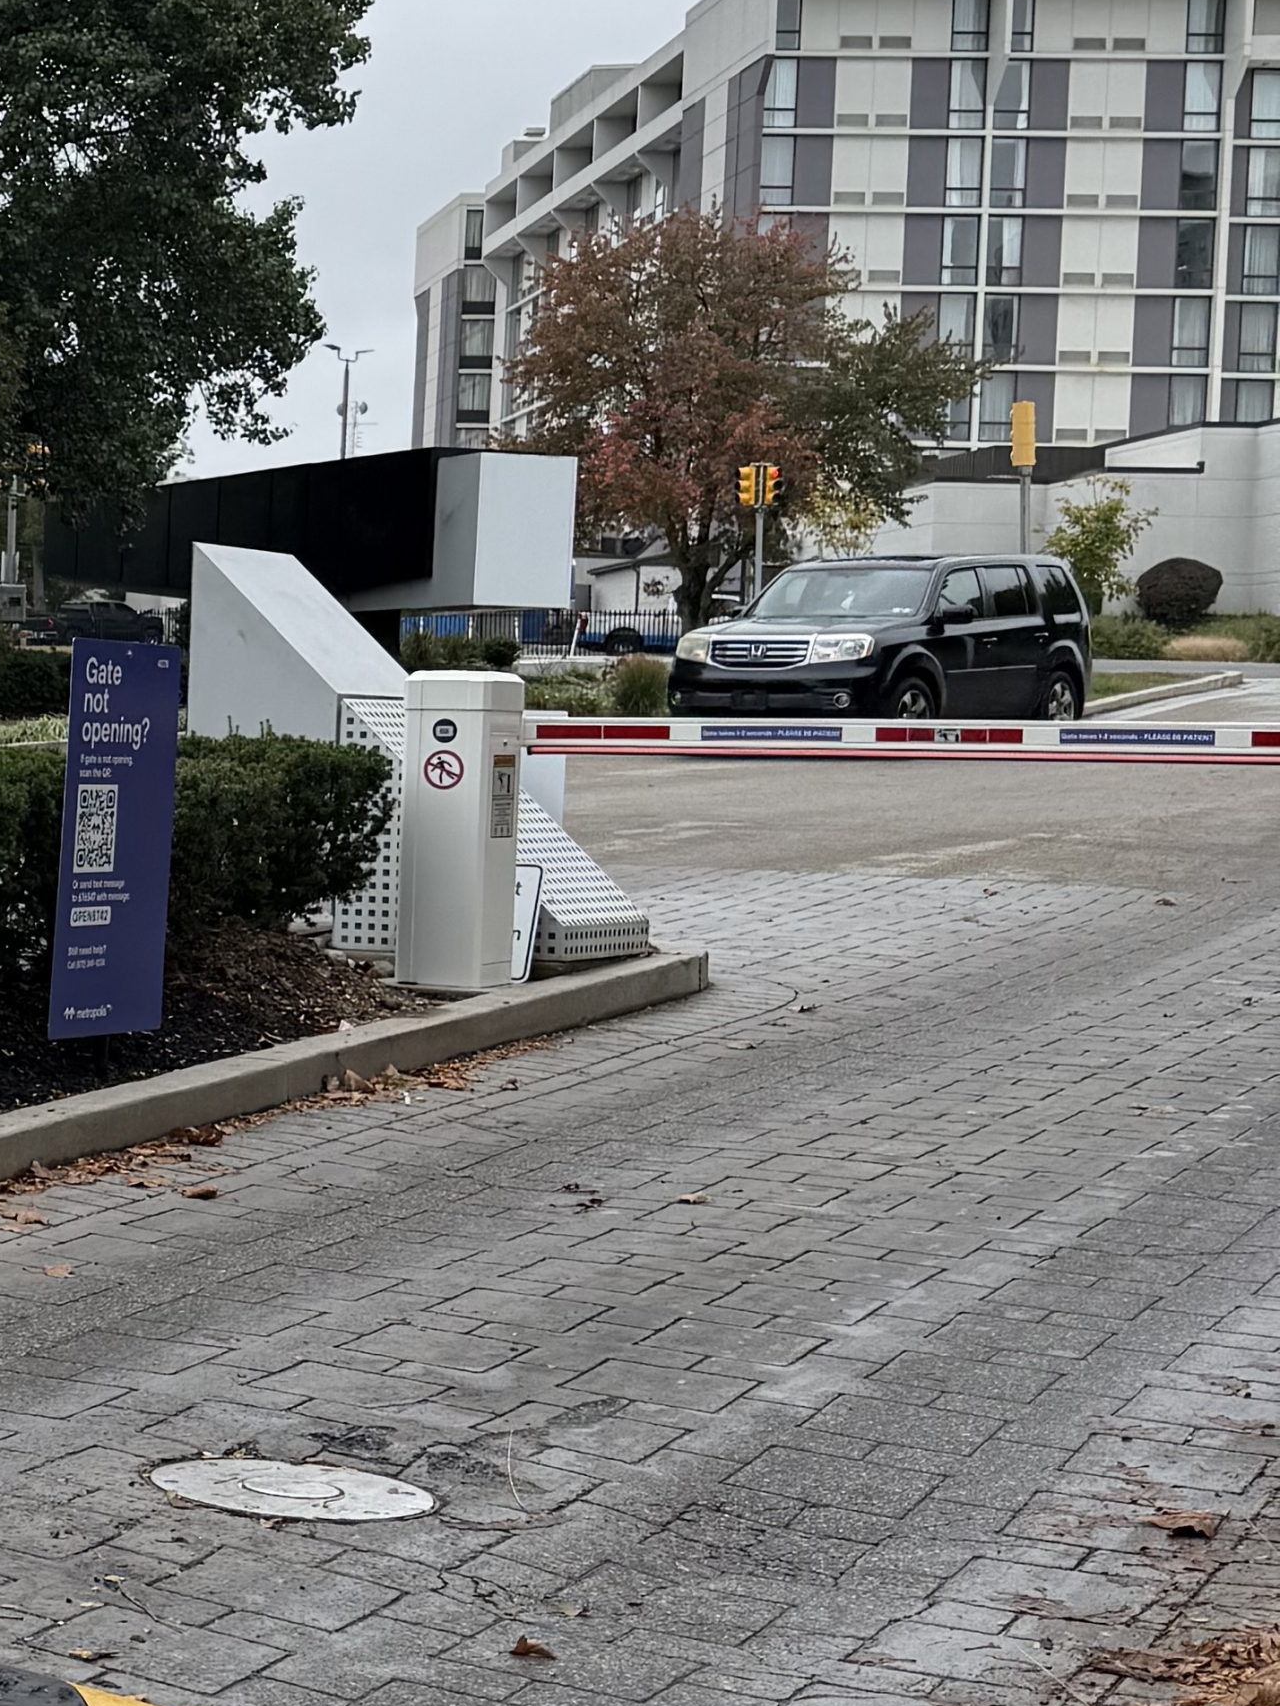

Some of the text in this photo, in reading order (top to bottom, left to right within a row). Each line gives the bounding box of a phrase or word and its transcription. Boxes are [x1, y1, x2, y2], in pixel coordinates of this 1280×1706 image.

[85, 656, 122, 685] Gate
[83, 688, 110, 713] not
[81, 716, 150, 751] opening?
[777, 729, 802, 737] PLEASE
[803, 730, 811, 738] BE
[812, 730, 841, 738] PATIENT
[1143, 732, 1171, 742] PLEASE
[1172, 733, 1181, 742] BE
[1182, 733, 1213, 743] PATIENT
[85, 755, 97, 766] gate
[102, 755, 112, 764] not
[79, 769, 92, 778] scan
[92, 768, 102, 777] the
[79, 879, 92, 889] send
[92, 879, 103, 889] text
[103, 879, 125, 890] message
[71, 893, 78, 902] to
[96, 892, 107, 902] with
[67, 944, 107, 957] Still need help?
[76, 1004, 107, 1020] metropolis
